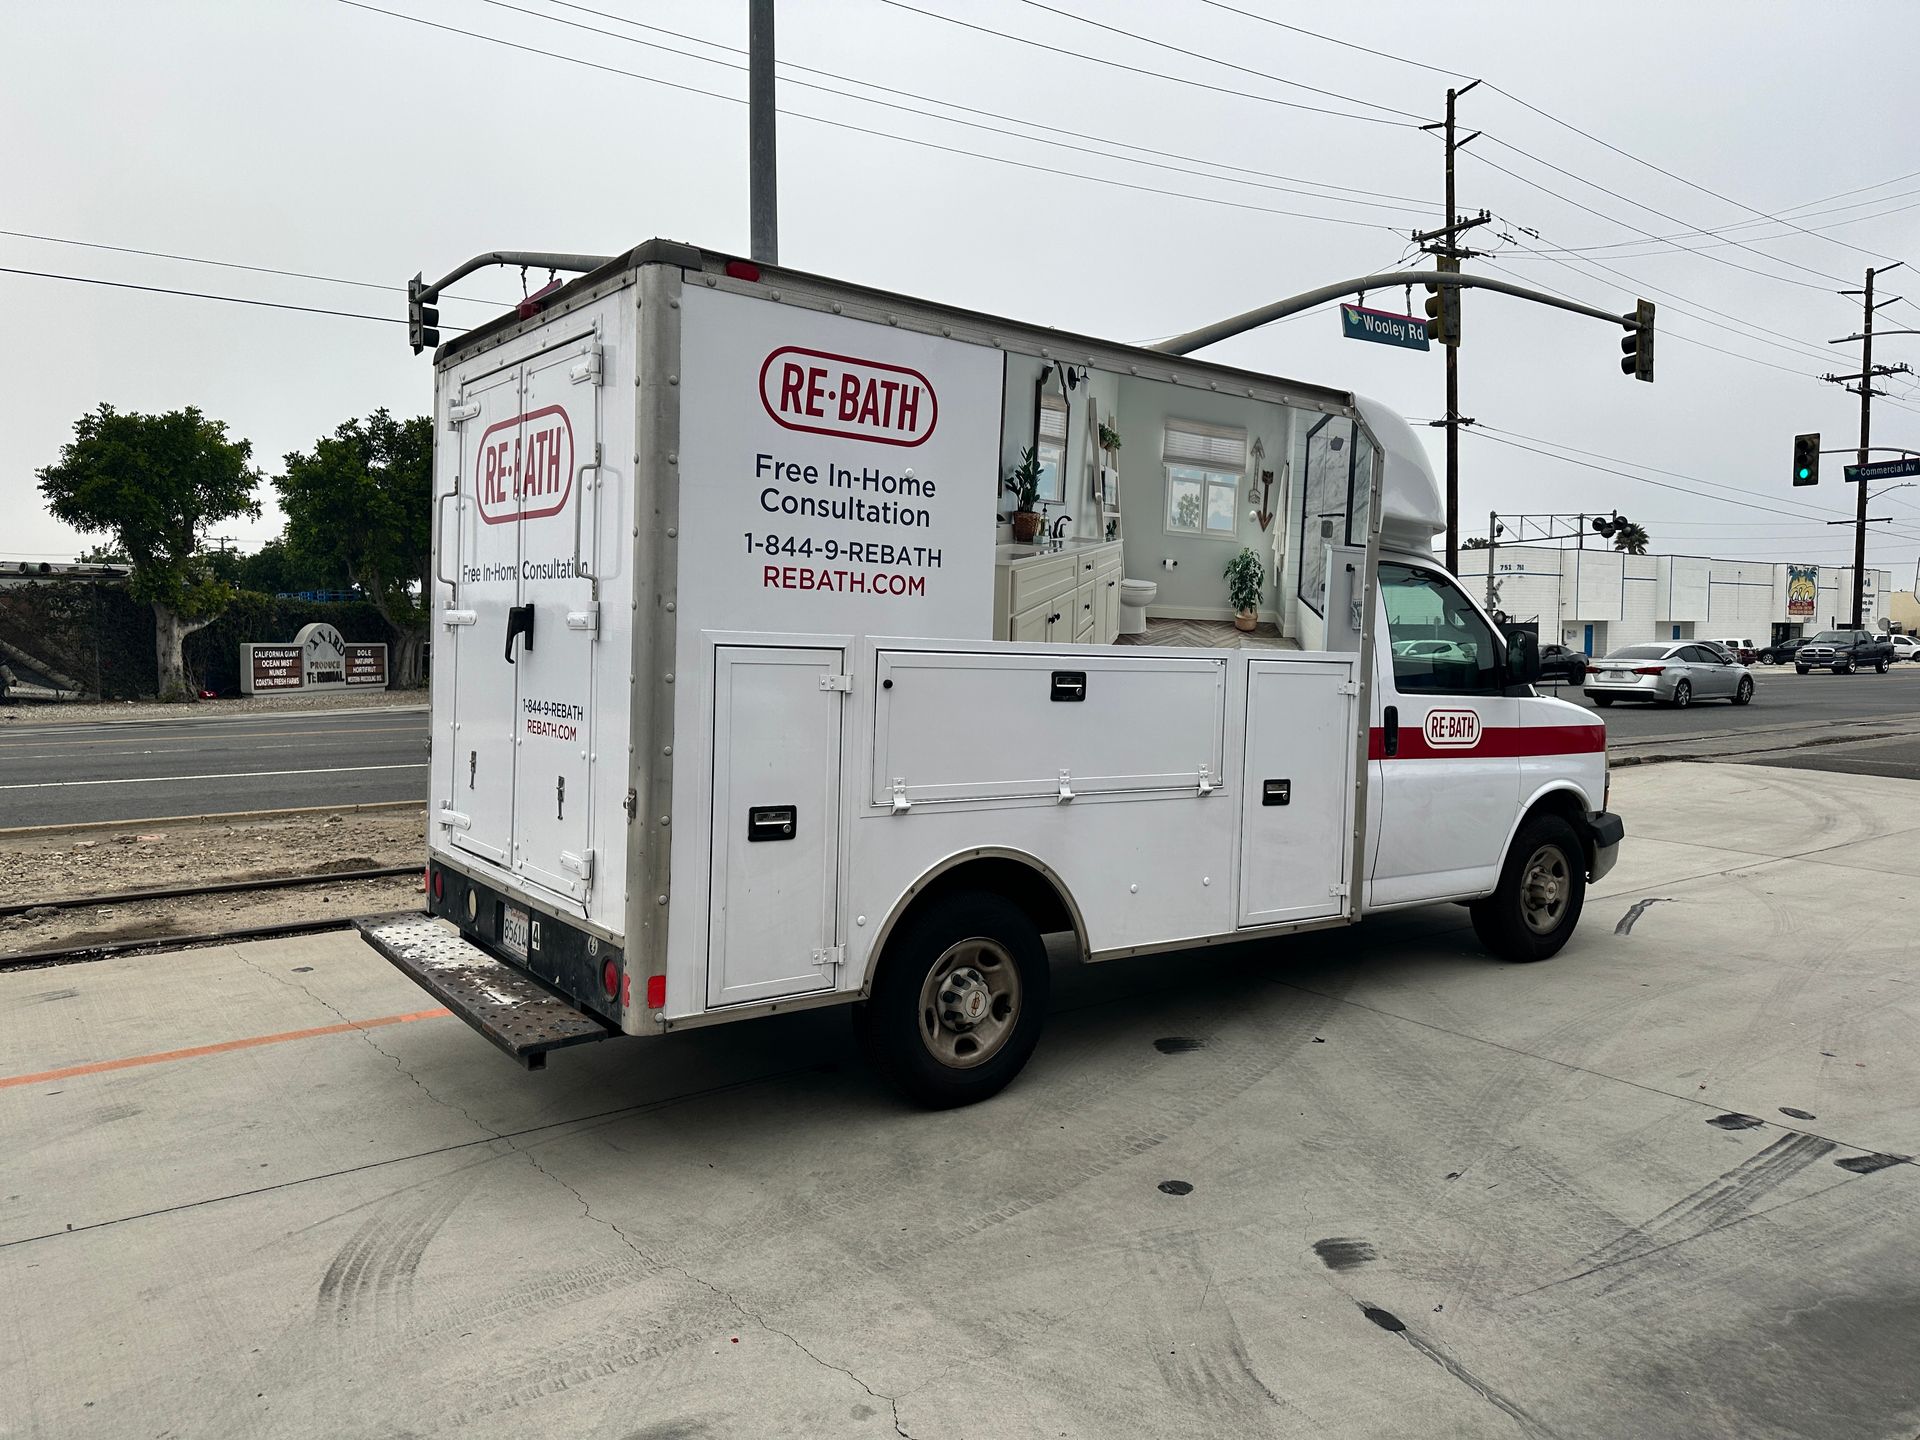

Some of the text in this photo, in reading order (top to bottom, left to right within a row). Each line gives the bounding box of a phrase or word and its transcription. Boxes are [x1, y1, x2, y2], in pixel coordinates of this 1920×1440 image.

[1363, 315, 1424, 341] Wooley Rd
[756, 453, 936, 498] Free In-Home
[1860, 463, 1916, 476] Commercial Av
[760, 488, 930, 527] Consultation
[744, 533, 942, 568] 1-844-9-REBATH
[463, 565, 481, 583] Free
[522, 557, 588, 580] Consultatin
[763, 565, 925, 596] REBATH.COM
[254, 650, 284, 658] CALIFORNIA
[357, 649, 372, 657] DOLE
[310, 661, 341, 670] PRODUCE
[256, 679, 274, 687] COASTAL
[287, 677, 299, 685] FARMS
[306, 671, 345, 684] TERMINAL
[523, 698, 583, 721] 1-844-9-REBATH
[527, 719, 577, 742] REBATH.COM
[533, 923, 540, 949] 4
